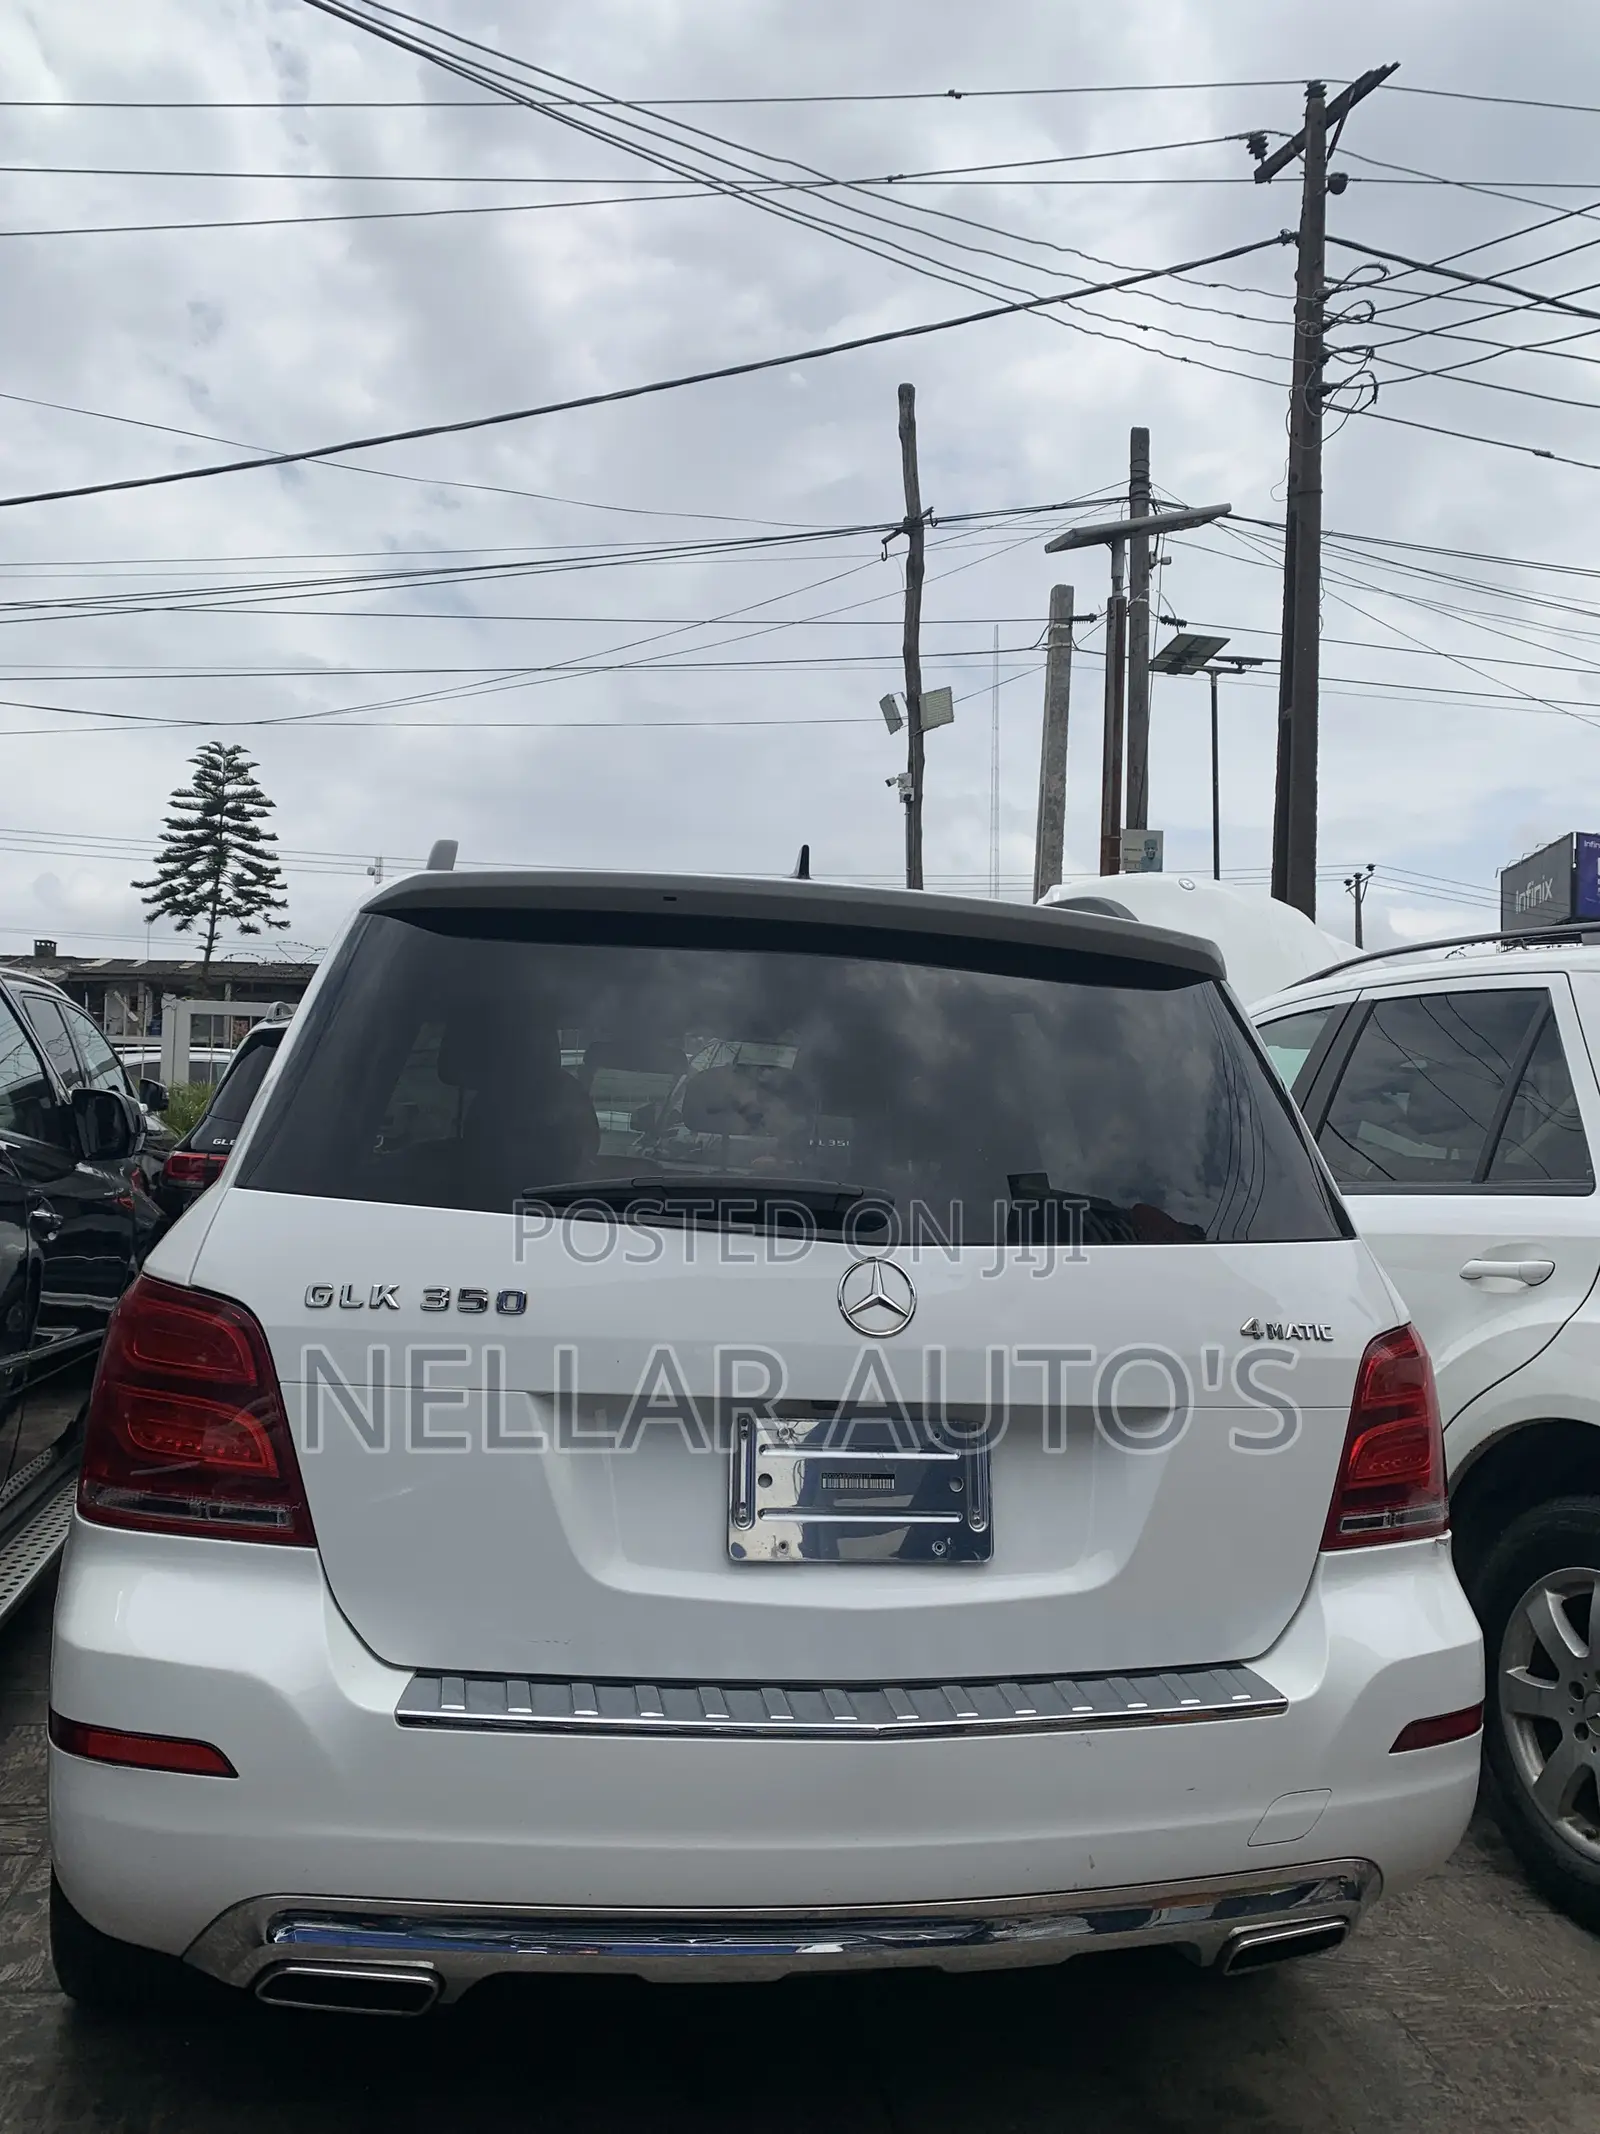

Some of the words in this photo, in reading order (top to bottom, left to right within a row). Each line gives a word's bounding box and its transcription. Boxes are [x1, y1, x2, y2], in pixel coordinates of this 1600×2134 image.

[1515, 875, 1553, 914] Infinix
[304, 1283, 401, 1310] GLK
[420, 1286, 528, 1315] 350
[1240, 1317, 1334, 1341] 4MATIC
